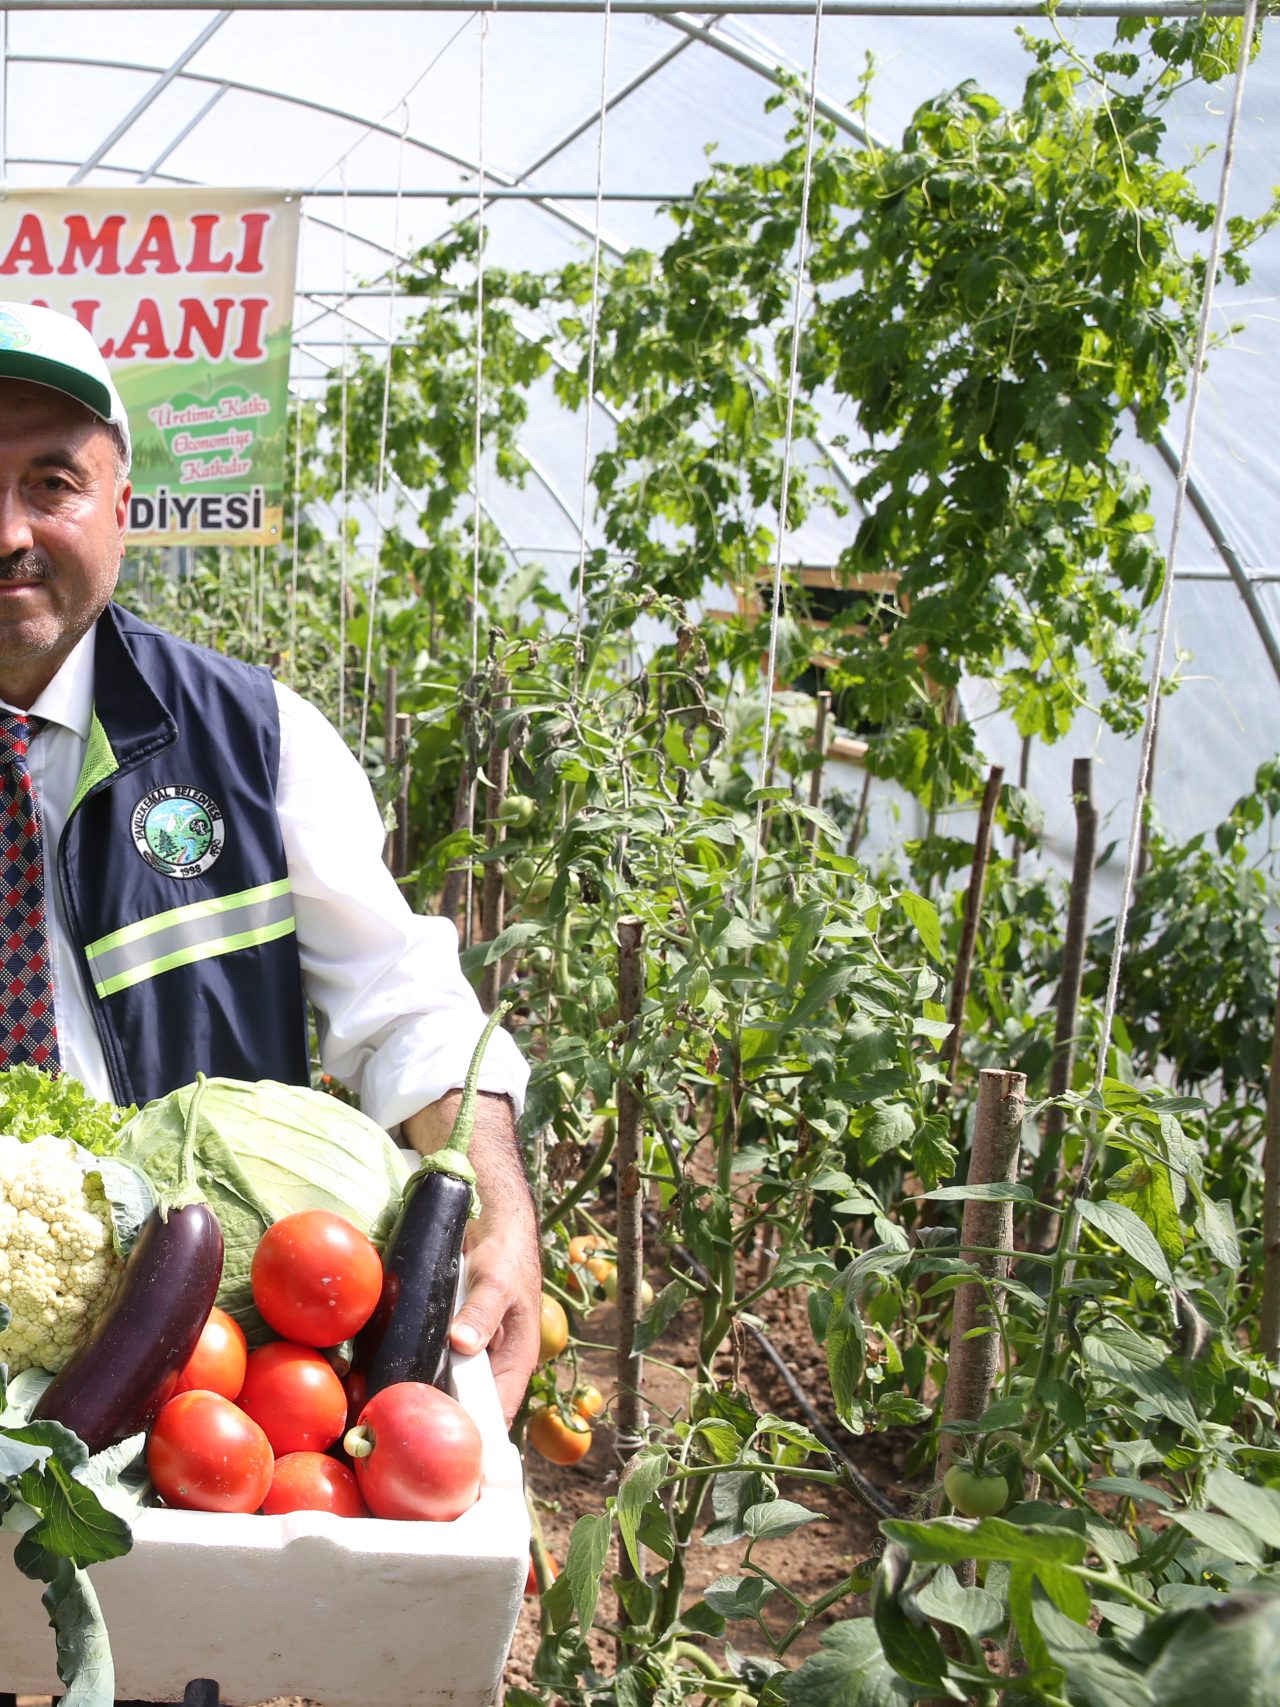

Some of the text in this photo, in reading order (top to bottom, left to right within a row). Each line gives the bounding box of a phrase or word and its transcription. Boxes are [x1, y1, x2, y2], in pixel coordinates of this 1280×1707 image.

[26, 298, 269, 360] LANI
[131, 489, 261, 528] DİYESİ
[134, 788, 171, 841] YAVUZKEMAL
[180, 864, 202, 878] 1998
